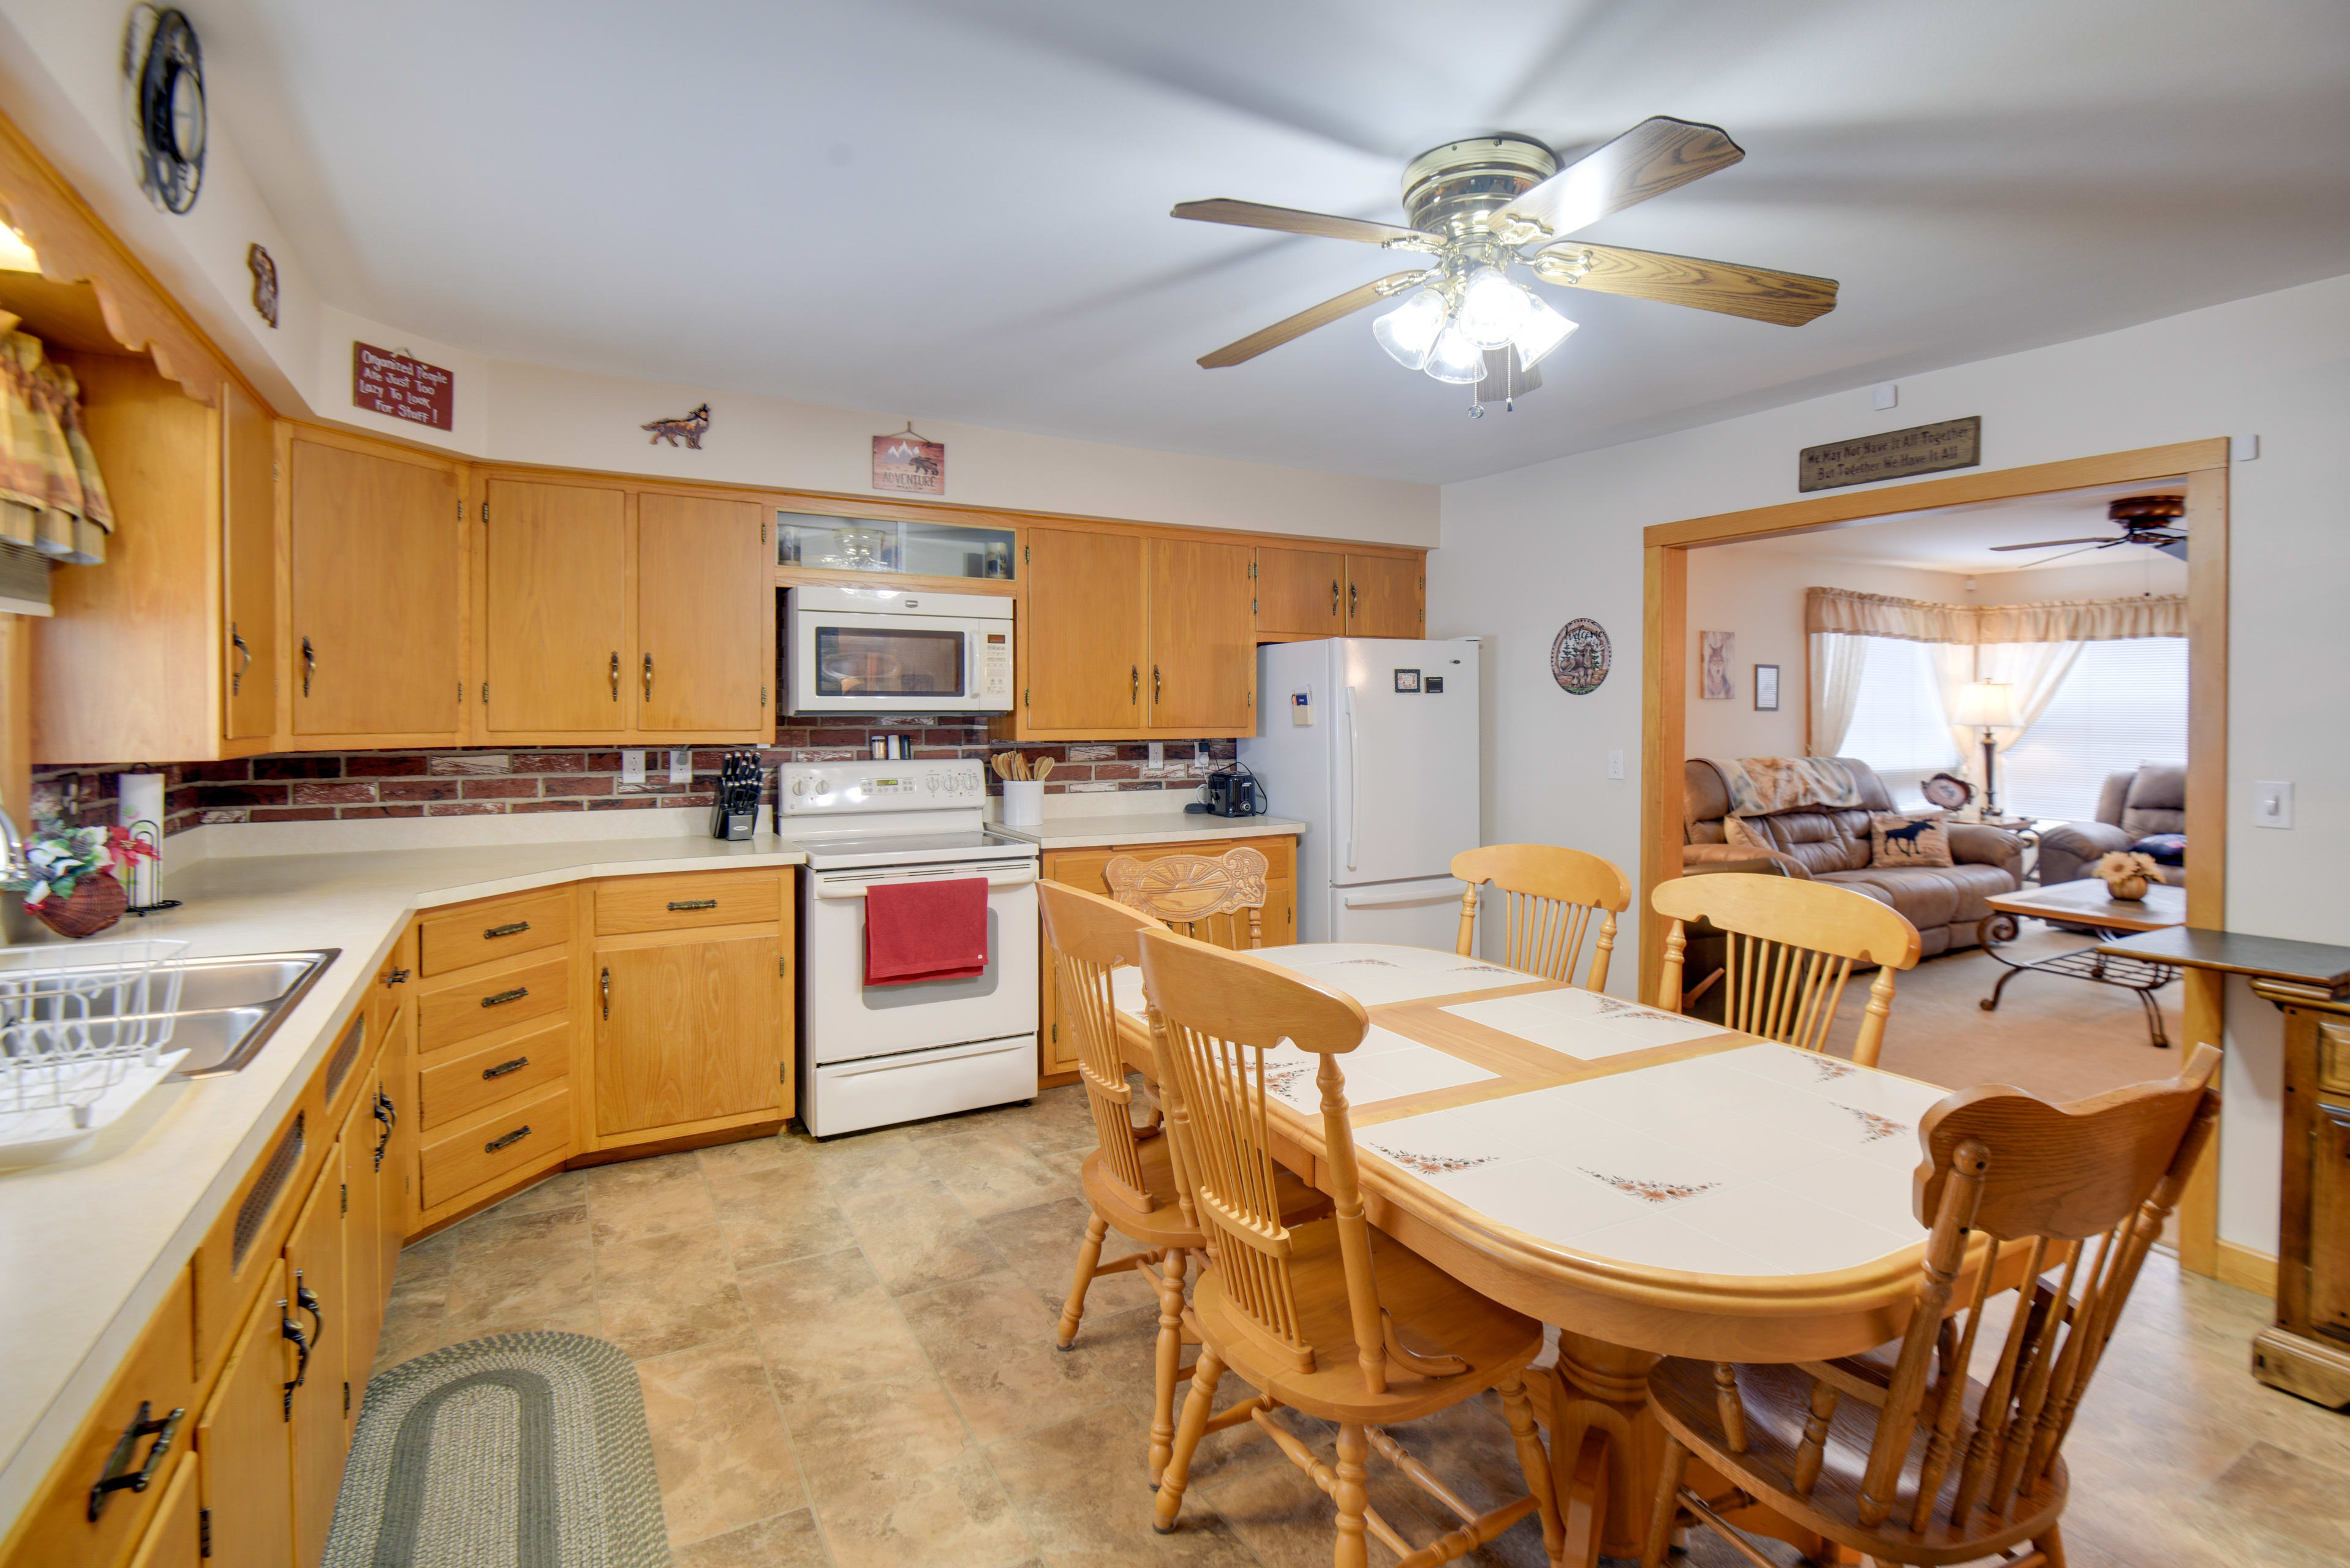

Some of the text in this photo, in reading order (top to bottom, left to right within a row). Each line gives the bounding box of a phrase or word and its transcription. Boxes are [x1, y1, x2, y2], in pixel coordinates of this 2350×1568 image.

[361, 350, 448, 386] Organized People
[363, 367, 435, 395] Are Just Too
[358, 379, 431, 409] Lazy To Look
[374, 399, 395, 413] For
[397, 403, 430, 423] Stuff
[1807, 428, 1968, 464] We May Not Have It All Together
[1818, 446, 1958, 481] But Together We Have It All
[883, 472, 936, 487] ADVENTURE
